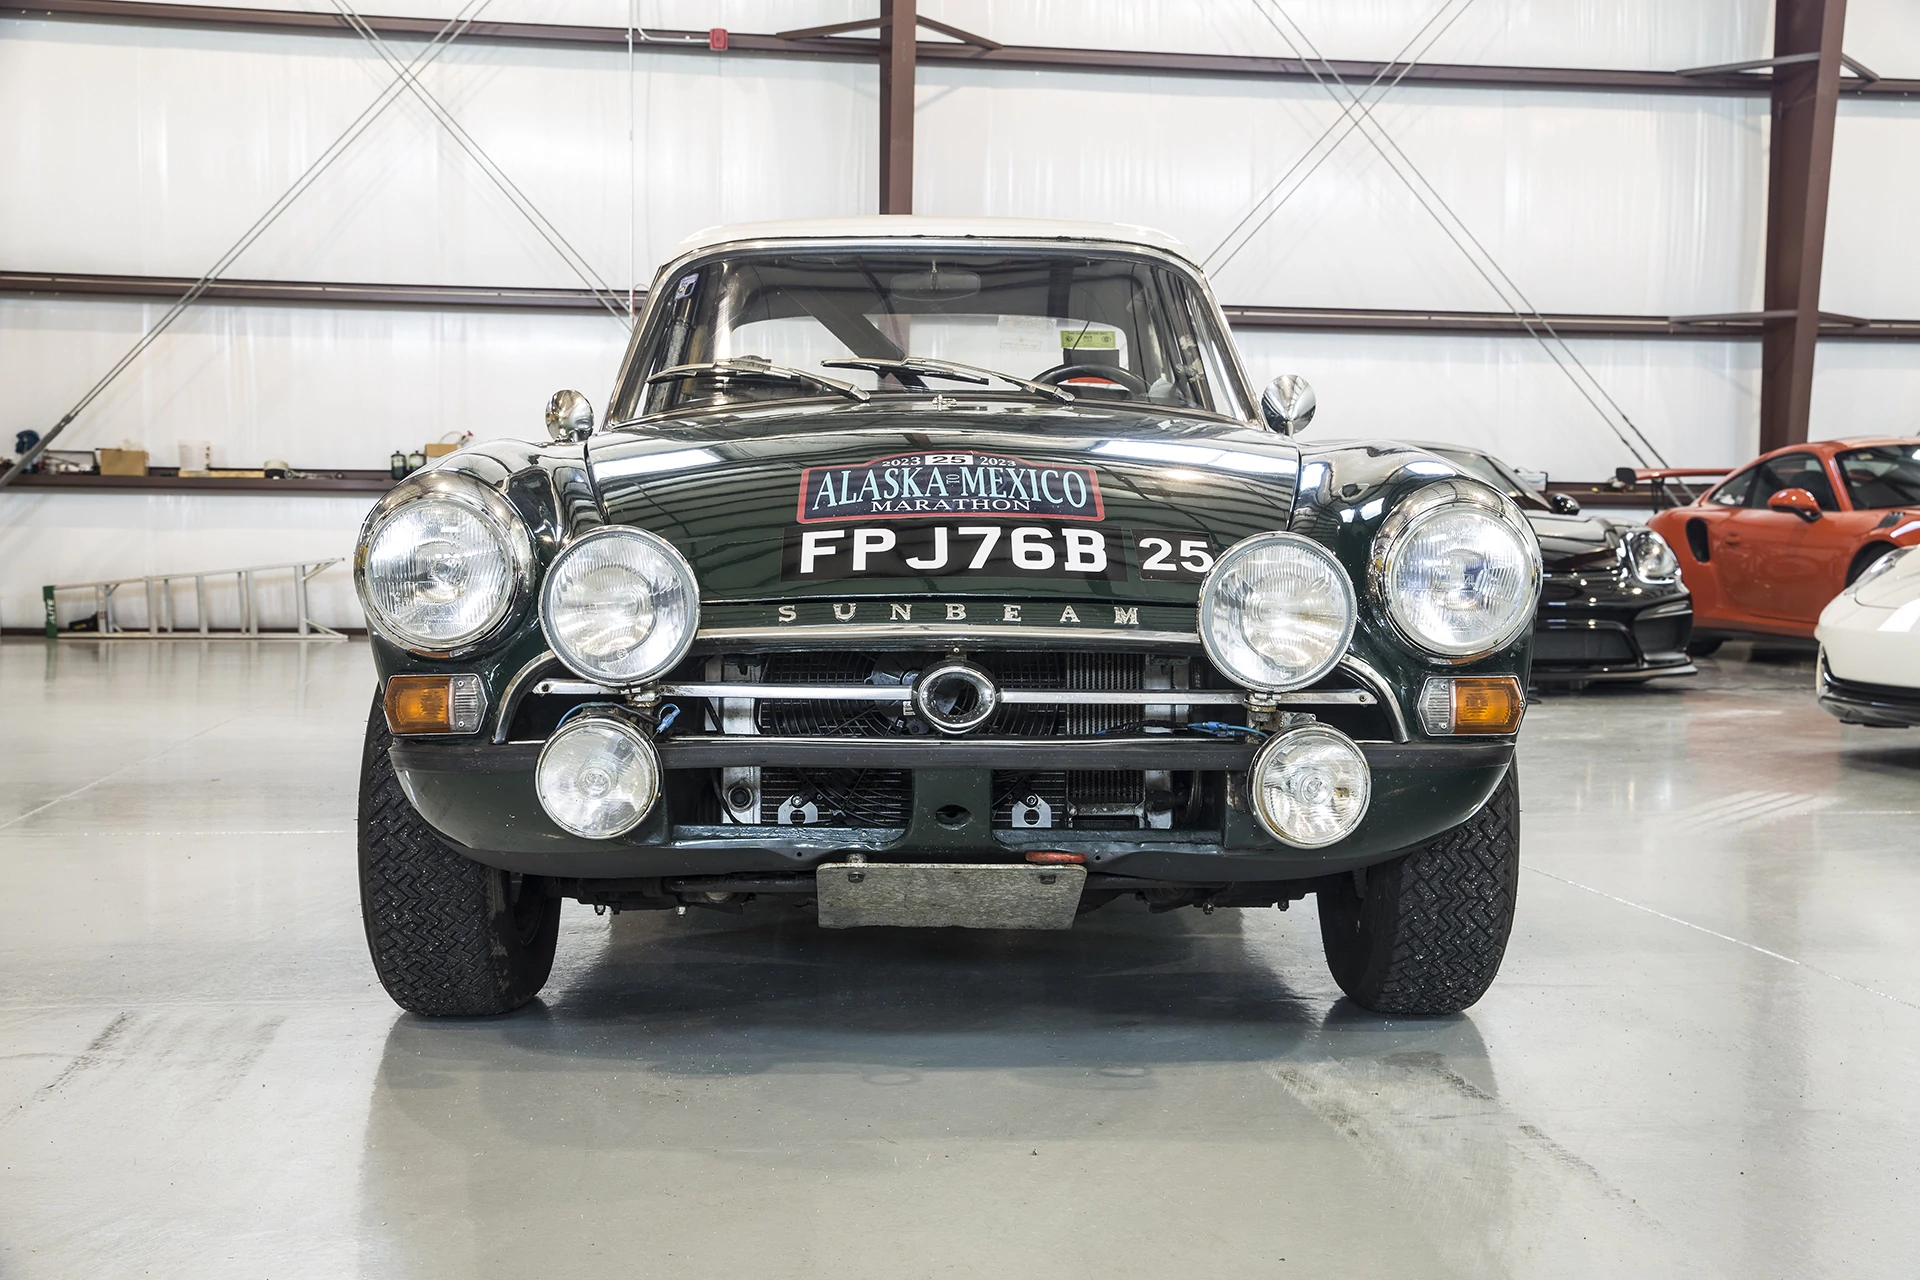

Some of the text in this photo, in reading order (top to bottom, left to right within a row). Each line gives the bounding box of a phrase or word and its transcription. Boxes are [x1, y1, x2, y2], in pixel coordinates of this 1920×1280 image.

[882, 456, 1017, 467] 2023 25 2023
[811, 466, 949, 511] ALASKA
[959, 466, 1087, 508] MEXICO
[870, 499, 1031, 513] MARATHON
[800, 526, 1107, 573] FPJ76B
[1139, 537, 1214, 573] 25
[778, 602, 1139, 625] SUNBEAM
